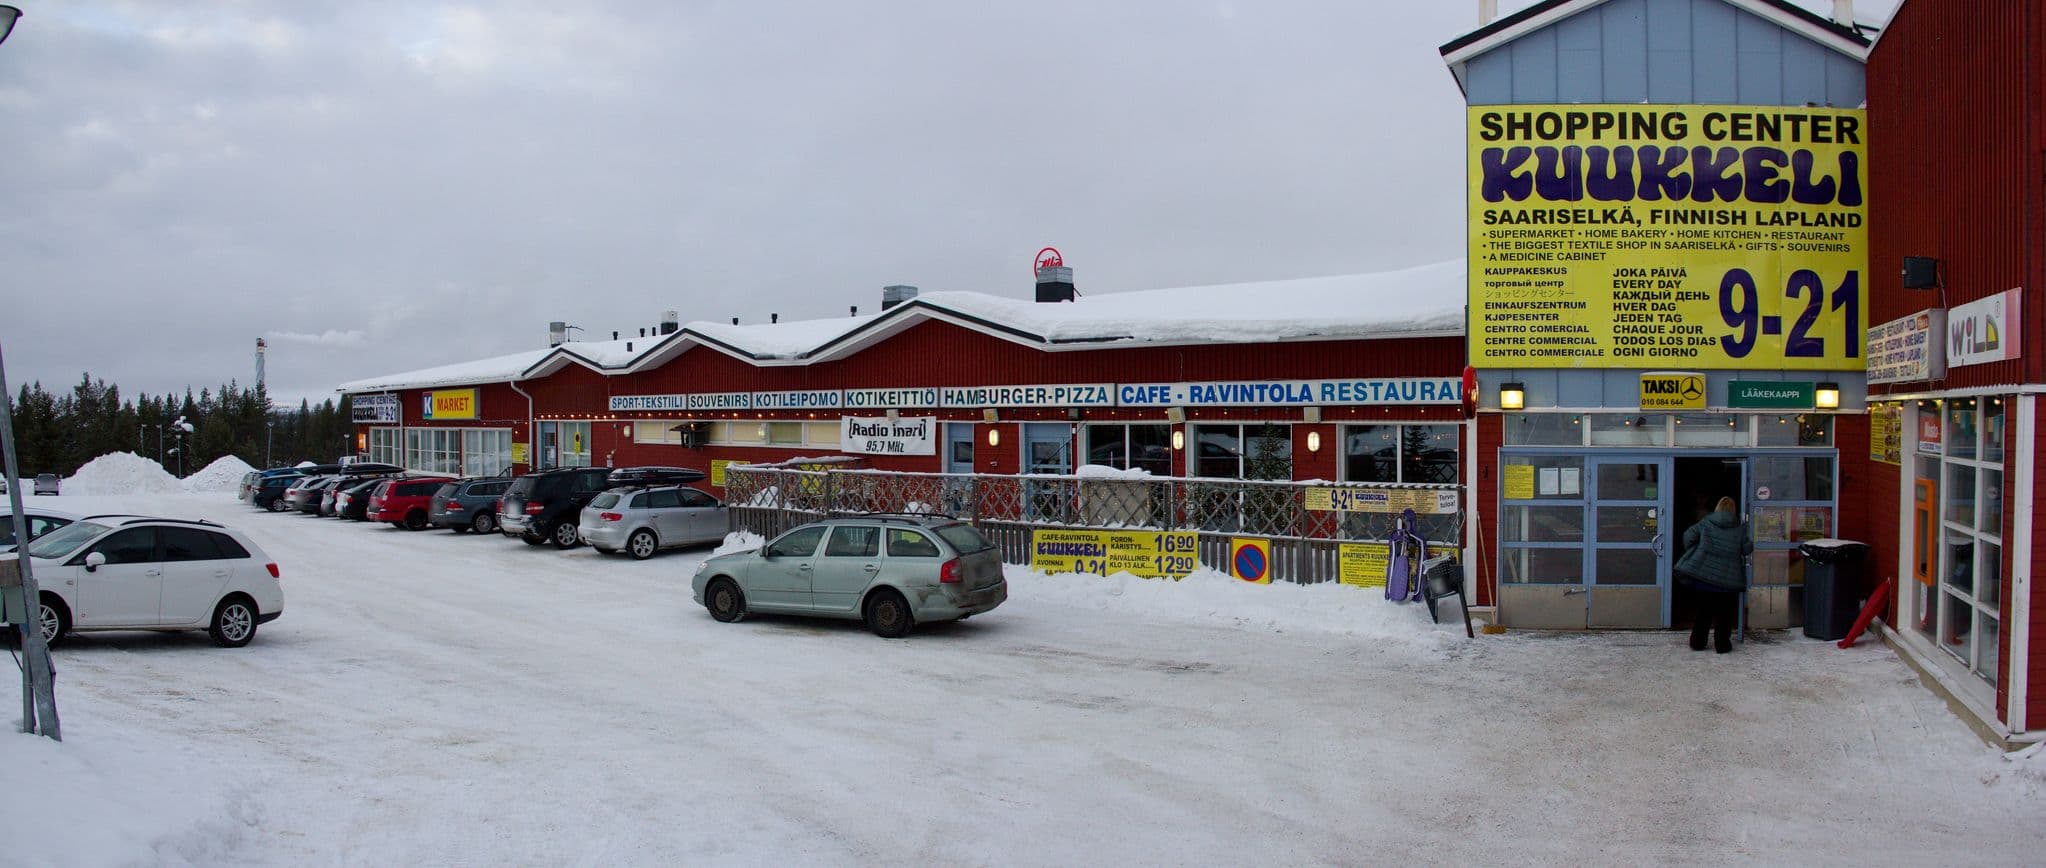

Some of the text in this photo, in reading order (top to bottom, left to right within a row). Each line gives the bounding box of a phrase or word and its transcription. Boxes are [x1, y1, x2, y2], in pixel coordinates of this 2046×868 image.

[1480, 112, 1859, 144] SHOPPING CENTER
[1481, 145, 1863, 207] KUUKKELI
[1483, 206, 1862, 228] SAARISELKÄ, FINNISH LAPLAND
[1489, 229, 1845, 241] SUPERMARKET HOME BAKERY HOME KITCHEN RESTAURANT
[1490, 240, 1850, 252] THE BIGGEST TEXTILE SHOP IN SAARISELKÄ GIFTS SOUVENIRS
[1489, 252, 1606, 261] A MEDICINE CABINET
[1485, 267, 1567, 275] KAUPPAKESKUS
[1613, 266, 1687, 277] JOKA PÄIVÄ
[1485, 280, 1564, 288] торговый центр
[1613, 280, 1681, 288] EVERY DAY
[1613, 290, 1710, 301] КАЖДЫЙ ДЕНЬ
[1613, 302, 1676, 311] HVER DAG
[1485, 313, 1559, 321] KJØPESENTER
[1613, 313, 1682, 323] JEDEN TAG
[1719, 268, 1859, 358] 9-21
[1485, 325, 1590, 333] CENTRO COMERCIAL
[1613, 325, 1703, 334] CHAQUE JOUR
[1613, 336, 1716, 346] TODOS LOS DIAS
[1530, 349, 1605, 357] COMMERCIALE
[1613, 347, 1698, 357] OGNI GIORNO
[1121, 385, 1172, 404] CAFE
[1189, 383, 1313, 403] RAVINTOLA
[1320, 381, 1464, 401] RESTAURA
[1642, 380, 1679, 394] TAKSI
[1741, 388, 1800, 398] LÄÄKEKAAPPI
[690, 394, 749, 408] SOUVENIRS
[755, 392, 838, 407] KOTILEIPOMO
[846, 389, 935, 406] KOTIKEITTIÖ
[944, 387, 1108, 404] HAMBURGER-PIZZA
[424, 396, 469, 414] K MARKET
[612, 397, 683, 409] SPORT-TEKSTIILI
[865, 441, 904, 453] 95,7 MHz
[1037, 542, 1107, 557] KUUKKELI
